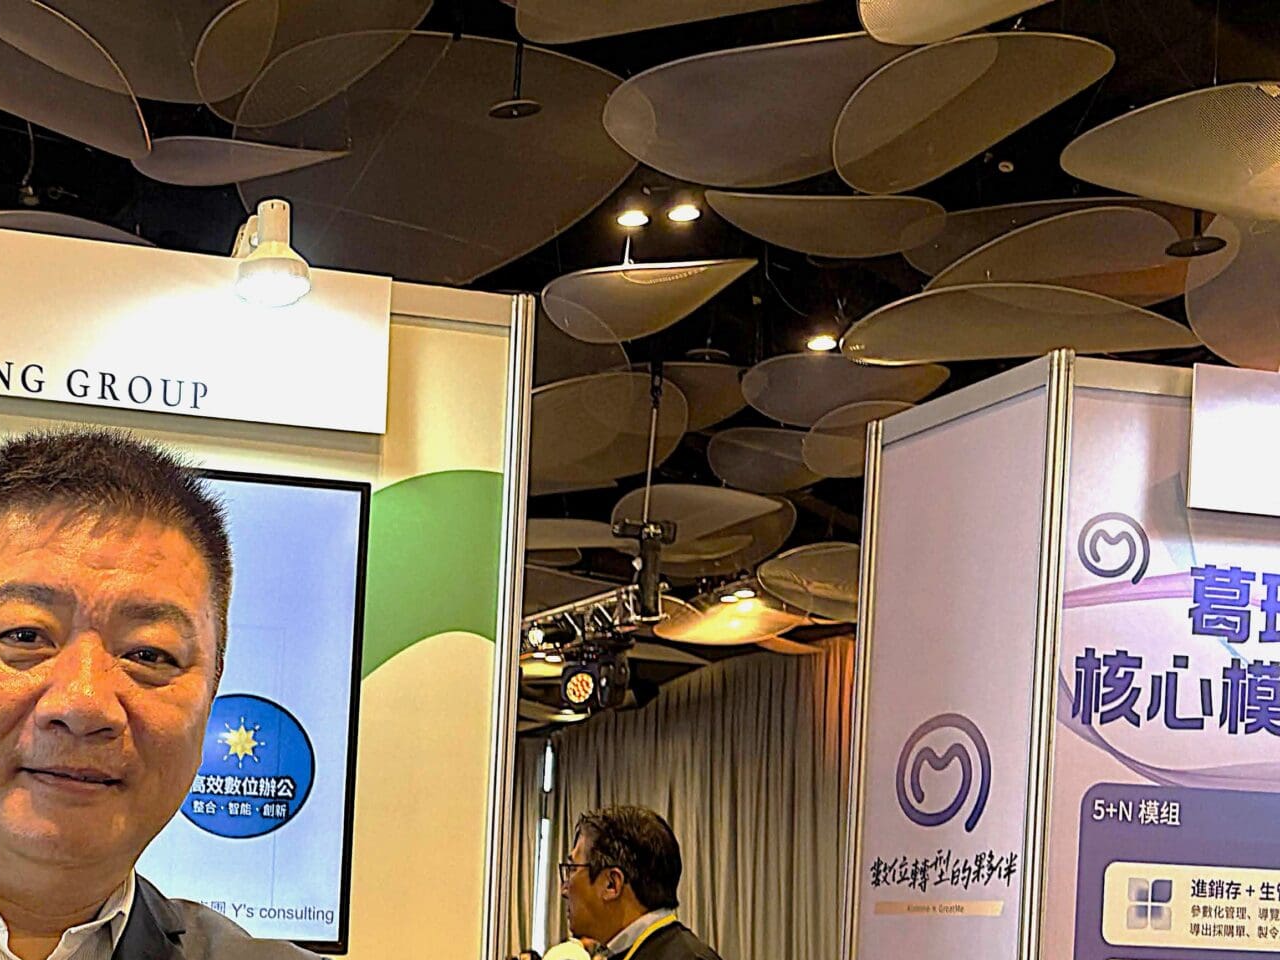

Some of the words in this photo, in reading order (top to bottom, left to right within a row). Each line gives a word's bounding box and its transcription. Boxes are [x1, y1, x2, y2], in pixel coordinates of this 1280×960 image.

[66, 368, 209, 411] GROUP
[1071, 648, 1280, 735] 核心模
[190, 774, 294, 798] 高效數位辦公
[1093, 799, 1133, 822] 5+N
[871, 849, 1018, 892] 數位轉型的夥伴
[1191, 879, 1241, 899] 進銷存
[1259, 882, 1280, 901] 生
[232, 905, 254, 917] Y's
[259, 906, 334, 924] consulting
